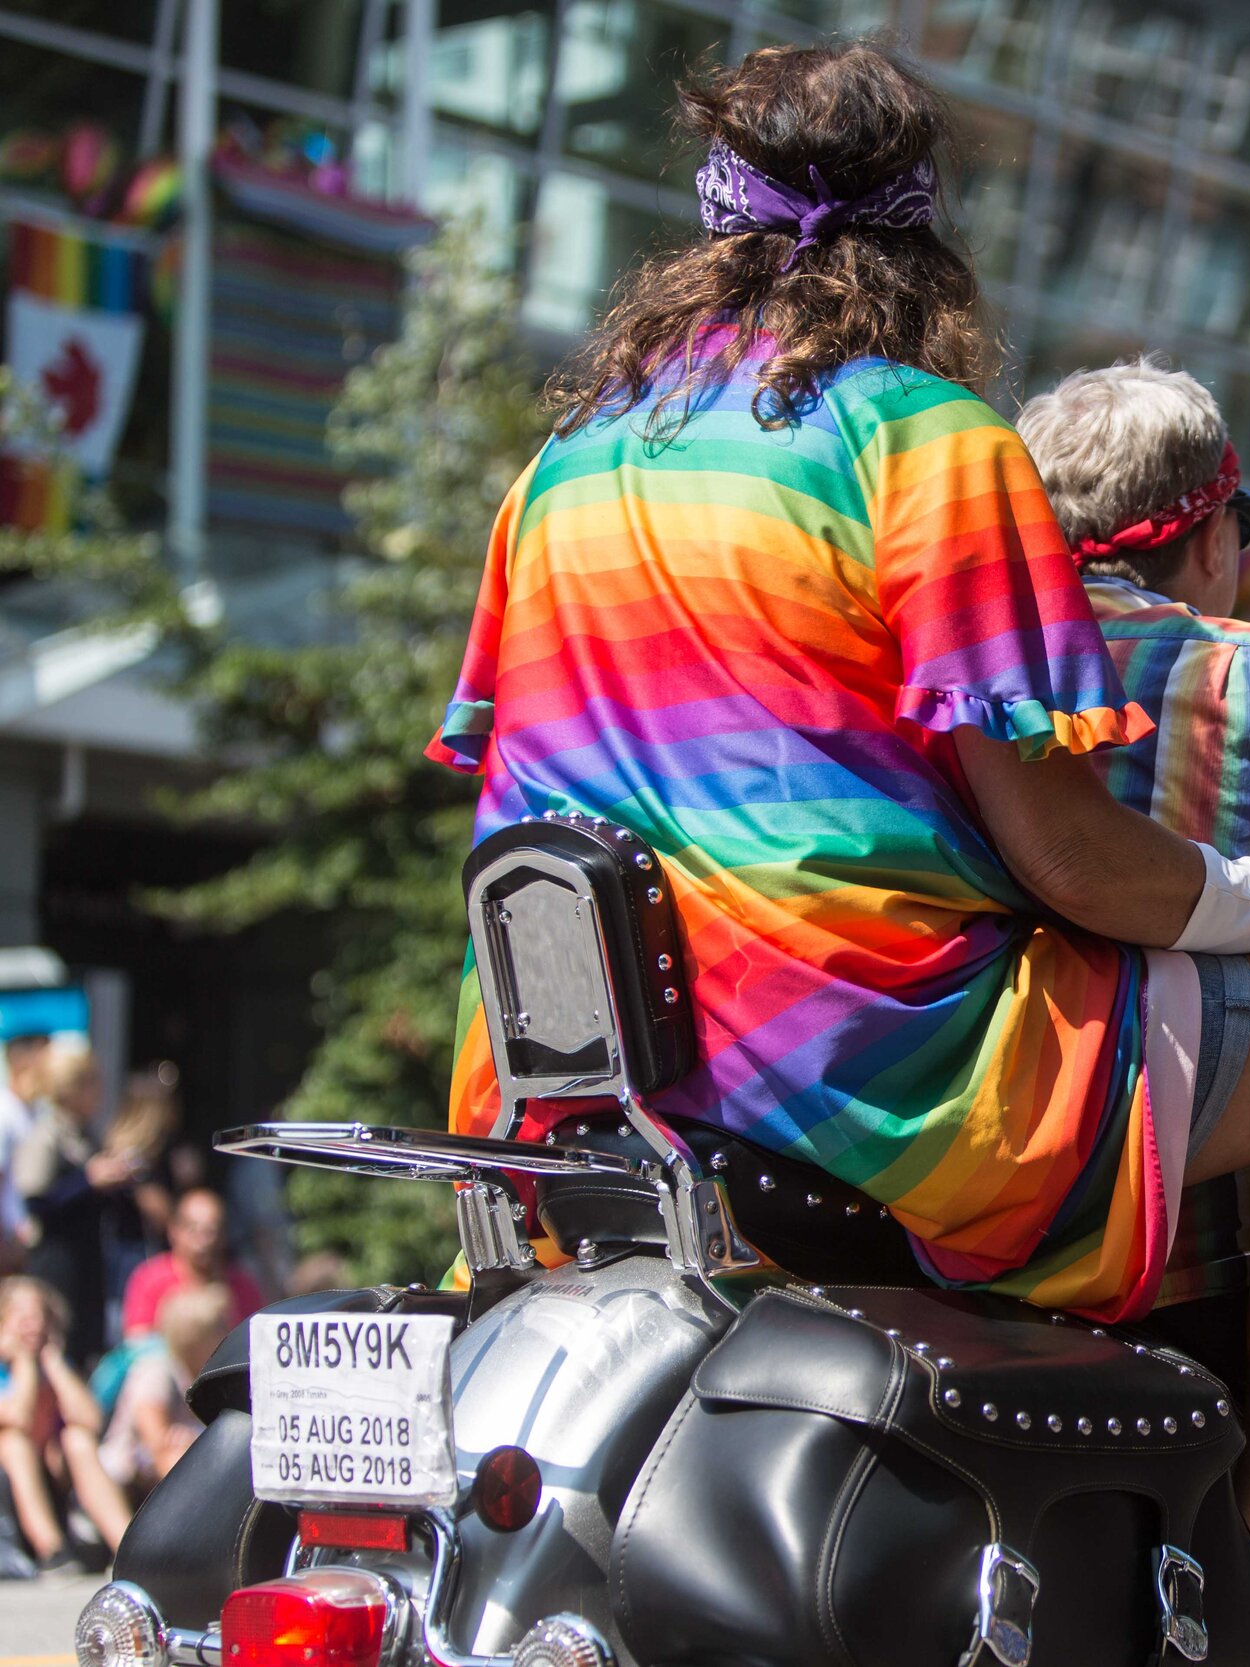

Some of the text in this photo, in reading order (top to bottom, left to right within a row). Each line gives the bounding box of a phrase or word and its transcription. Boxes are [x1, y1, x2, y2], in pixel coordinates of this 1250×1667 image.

[276, 1321, 412, 1370] 8M5Y9K
[279, 1415, 410, 1446] 05 AUG 2018
[279, 1453, 412, 1486] 05 AUG 2018
